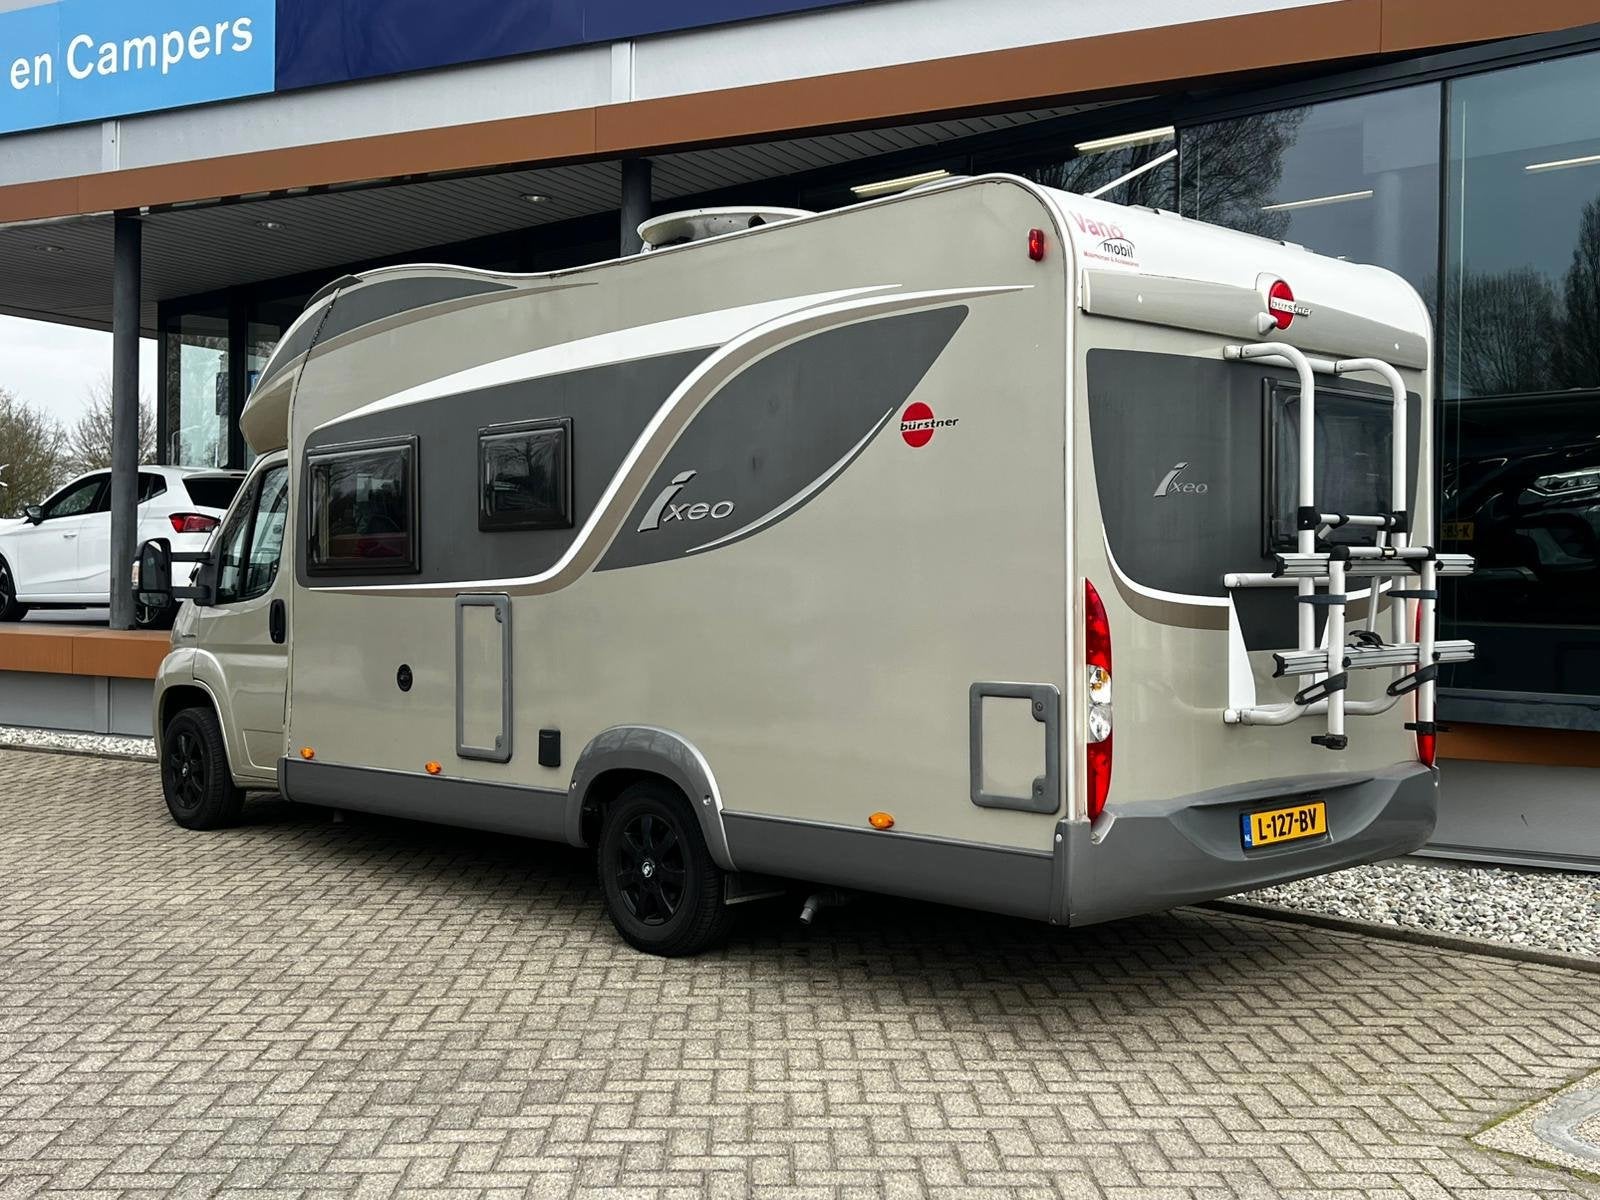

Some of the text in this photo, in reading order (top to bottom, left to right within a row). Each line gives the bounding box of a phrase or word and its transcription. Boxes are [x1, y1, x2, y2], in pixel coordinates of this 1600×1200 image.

[10, 17, 253, 90] en Campers
[1069, 210, 1124, 239] Vano
[1103, 242, 1134, 258] mobil
[900, 419, 959, 432] bürstner
[1258, 808, 1317, 841] L-127-BV
